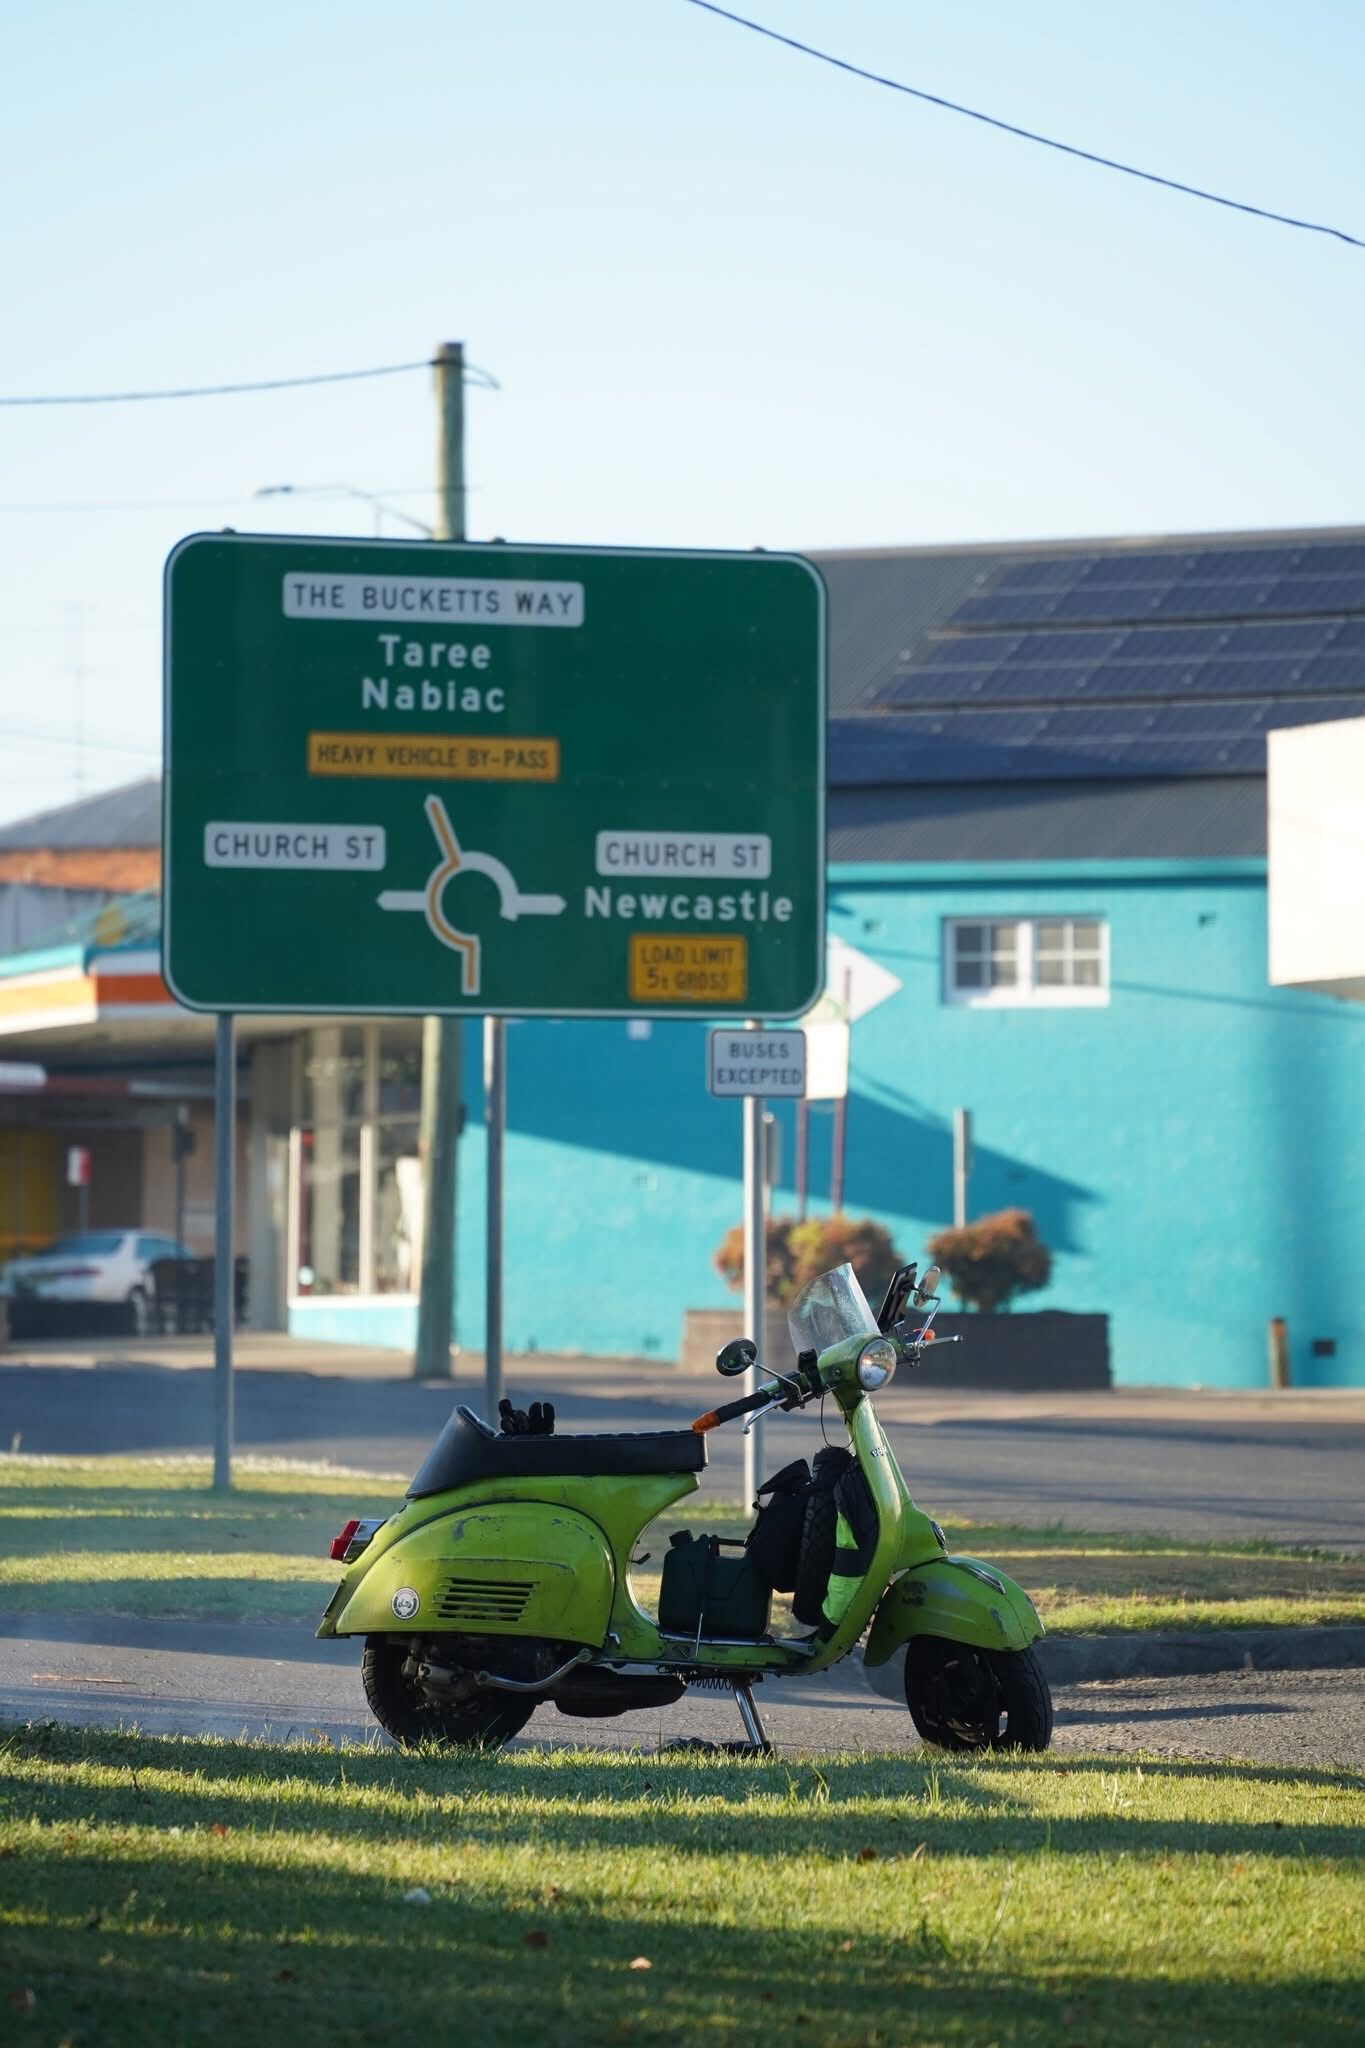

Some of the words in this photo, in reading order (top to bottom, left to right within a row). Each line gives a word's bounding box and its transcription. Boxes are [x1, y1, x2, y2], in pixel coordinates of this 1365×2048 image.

[292, 583, 345, 609] THE
[362, 585, 500, 614] BUCKETTS
[514, 591, 574, 615] WAY
[377, 633, 492, 669] Taree
[361, 676, 506, 712] Nabiac
[317, 743, 377, 765] HEAVY
[386, 745, 455, 768] VEHICLE
[467, 748, 550, 770] BY-PASS
[213, 832, 329, 859] CHURCH
[345, 835, 377, 860] ST
[604, 841, 717, 868] CHURCH
[732, 844, 762, 868] ST
[584, 885, 794, 922] Newcastle
[640, 945, 685, 965] LOAD
[691, 946, 735, 966] LIMIT
[675, 970, 729, 991] GROSS
[729, 1042, 790, 1060] BUSES
[716, 1067, 802, 1086] EXCEPTED
